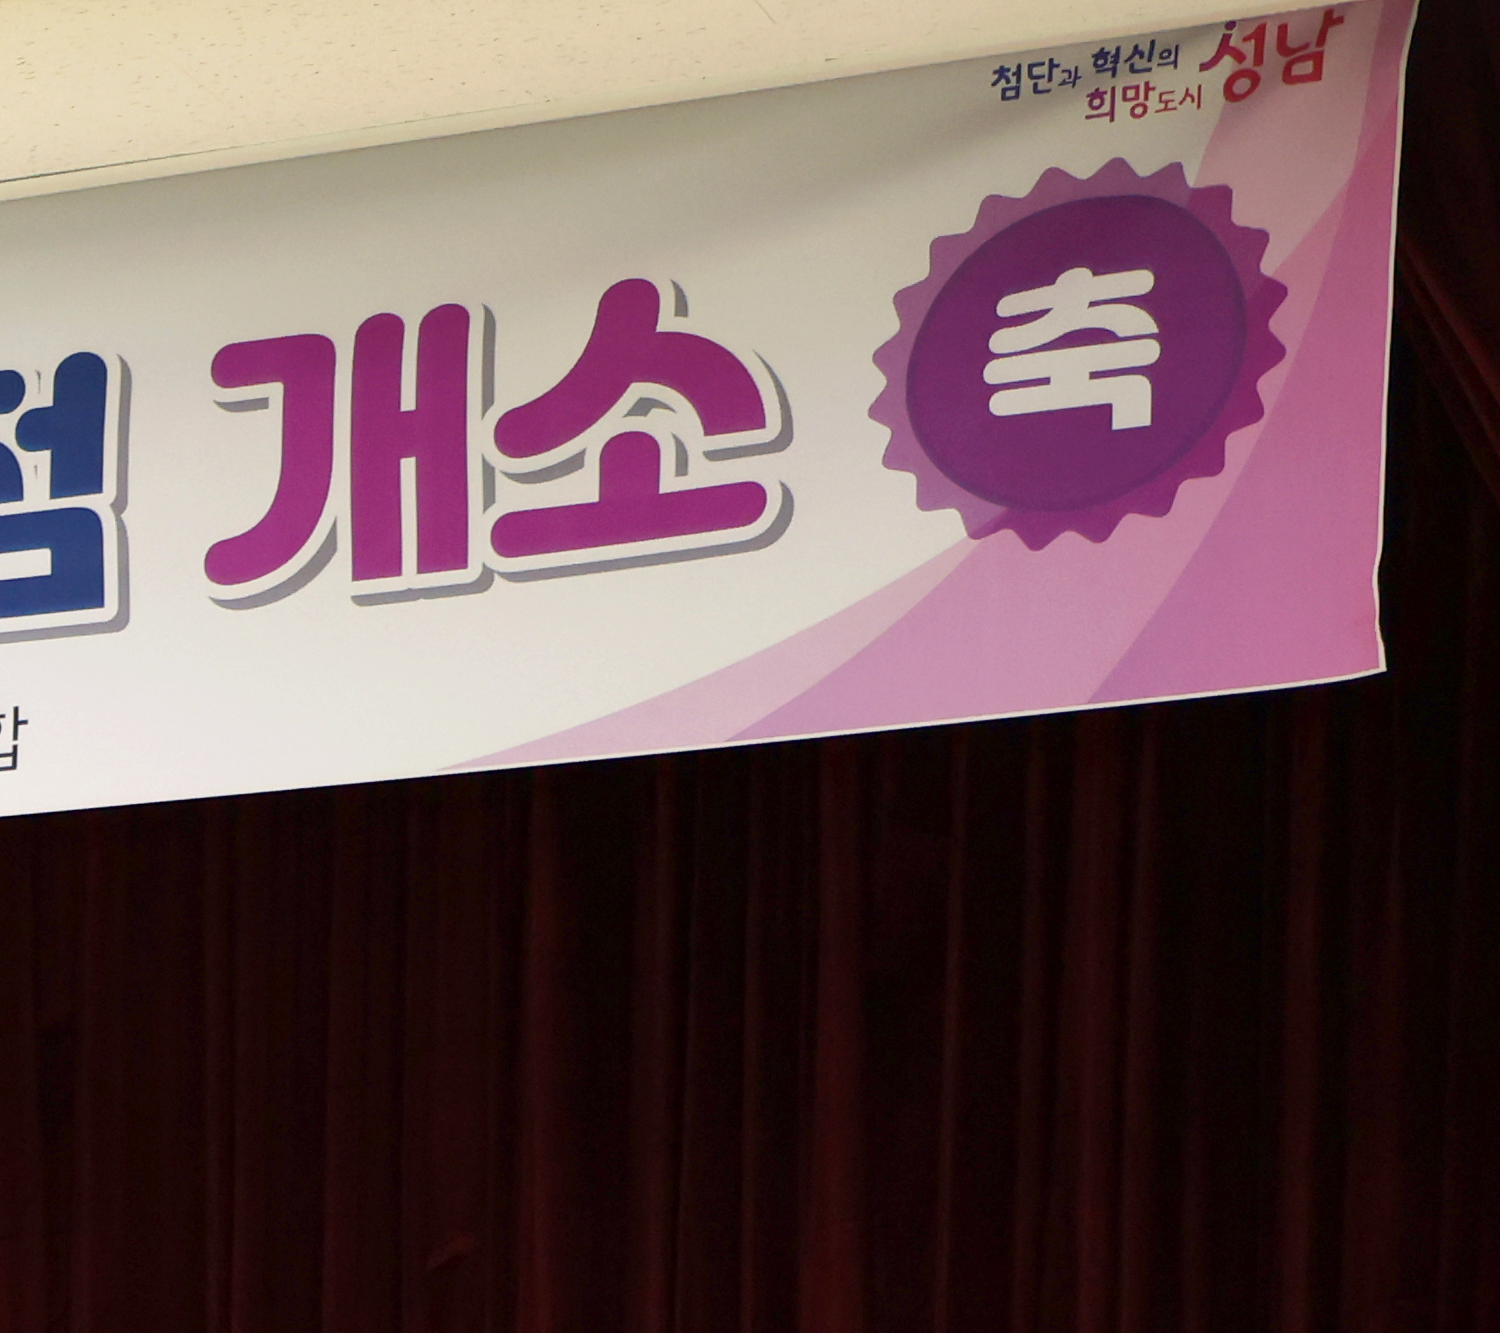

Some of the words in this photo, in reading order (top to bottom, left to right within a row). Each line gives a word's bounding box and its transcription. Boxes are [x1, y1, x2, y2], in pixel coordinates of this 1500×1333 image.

[991, 57, 1082, 101] 첨단과
[1091, 39, 1180, 79] 혁신의
[1085, 80, 1203, 123] 희망도시
[1200, 8, 1345, 102] 성남
[983, 266, 1162, 432] 축
[205, 278, 768, 586] 개소
